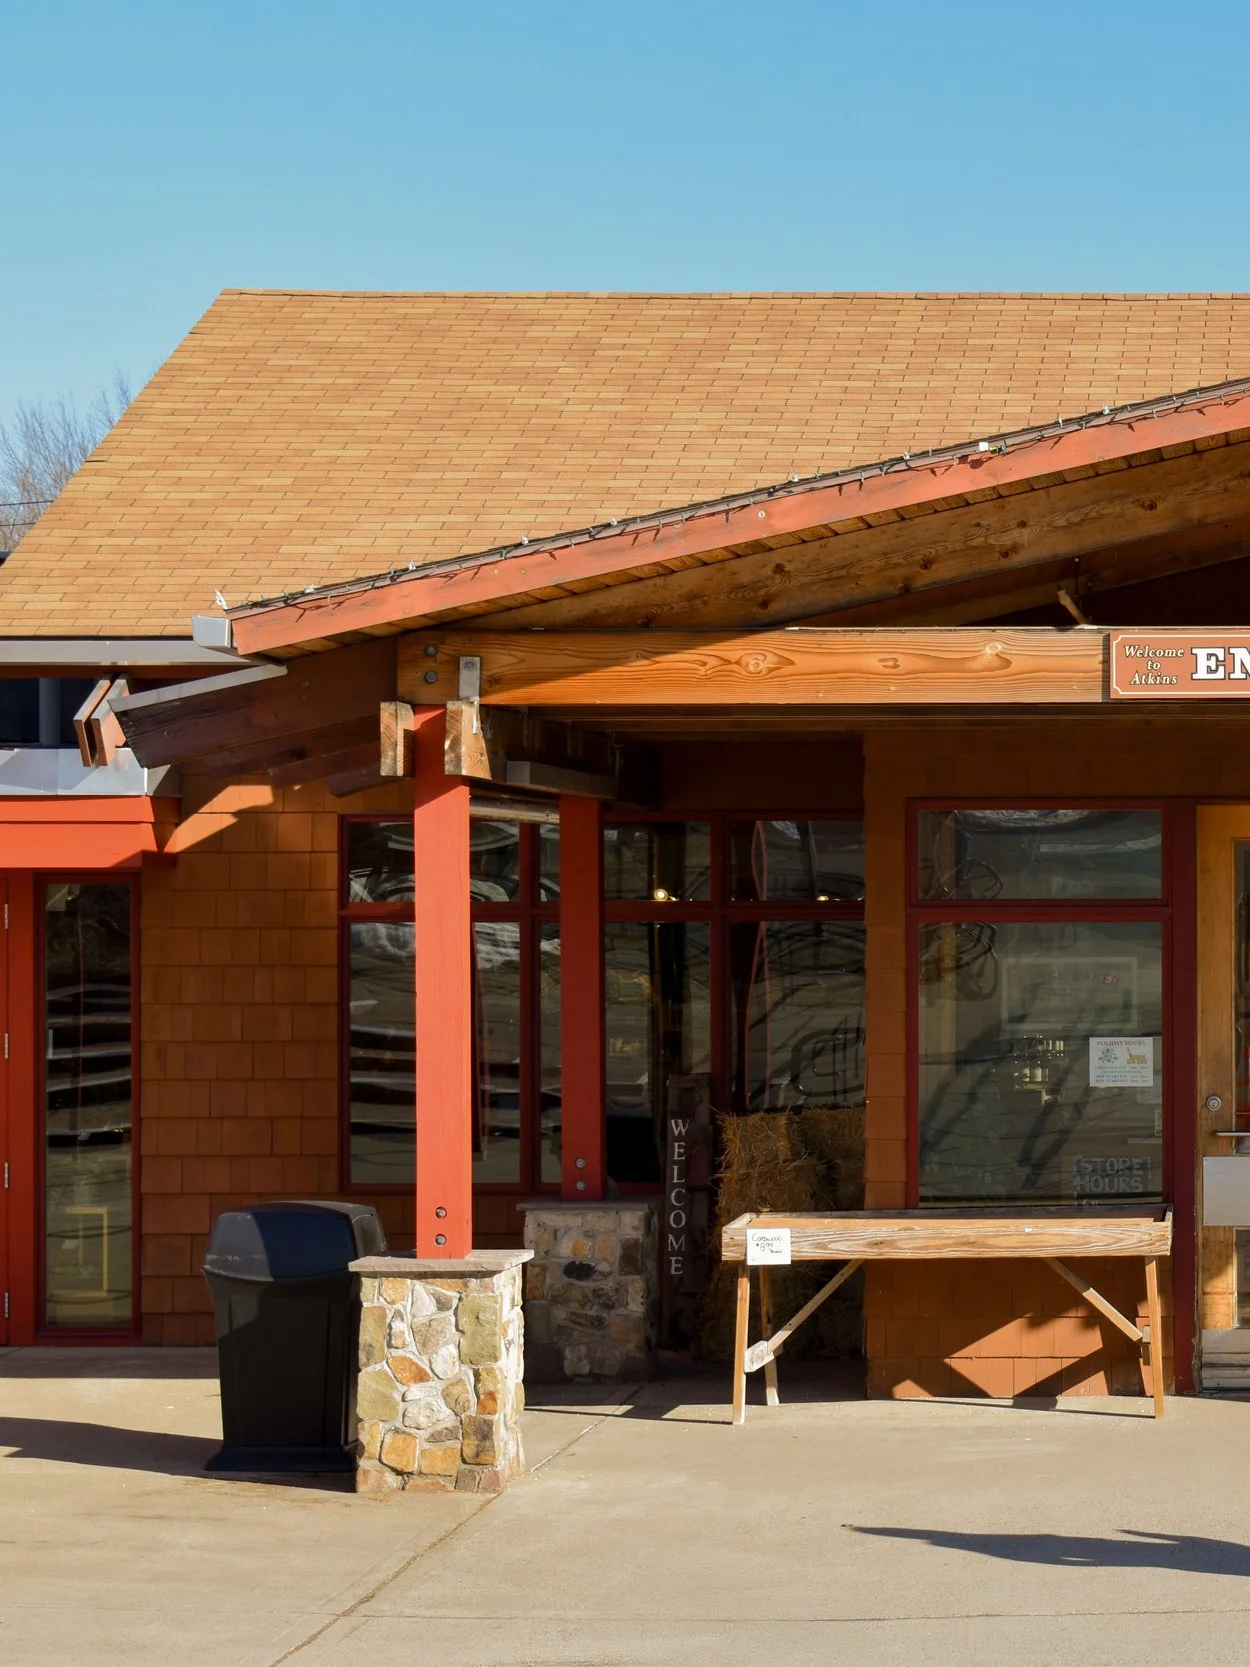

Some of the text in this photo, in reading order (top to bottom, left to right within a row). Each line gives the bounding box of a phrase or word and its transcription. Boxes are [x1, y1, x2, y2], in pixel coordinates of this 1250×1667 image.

[1124, 645, 1184, 658] Welcome
[1147, 660, 1161, 671] to
[1130, 671, 1179, 685] Atkins
[1081, 1158, 1144, 1174] STORE
[1075, 1176, 1143, 1192] HOURS
[668, 1119, 689, 1275] WELCOME
